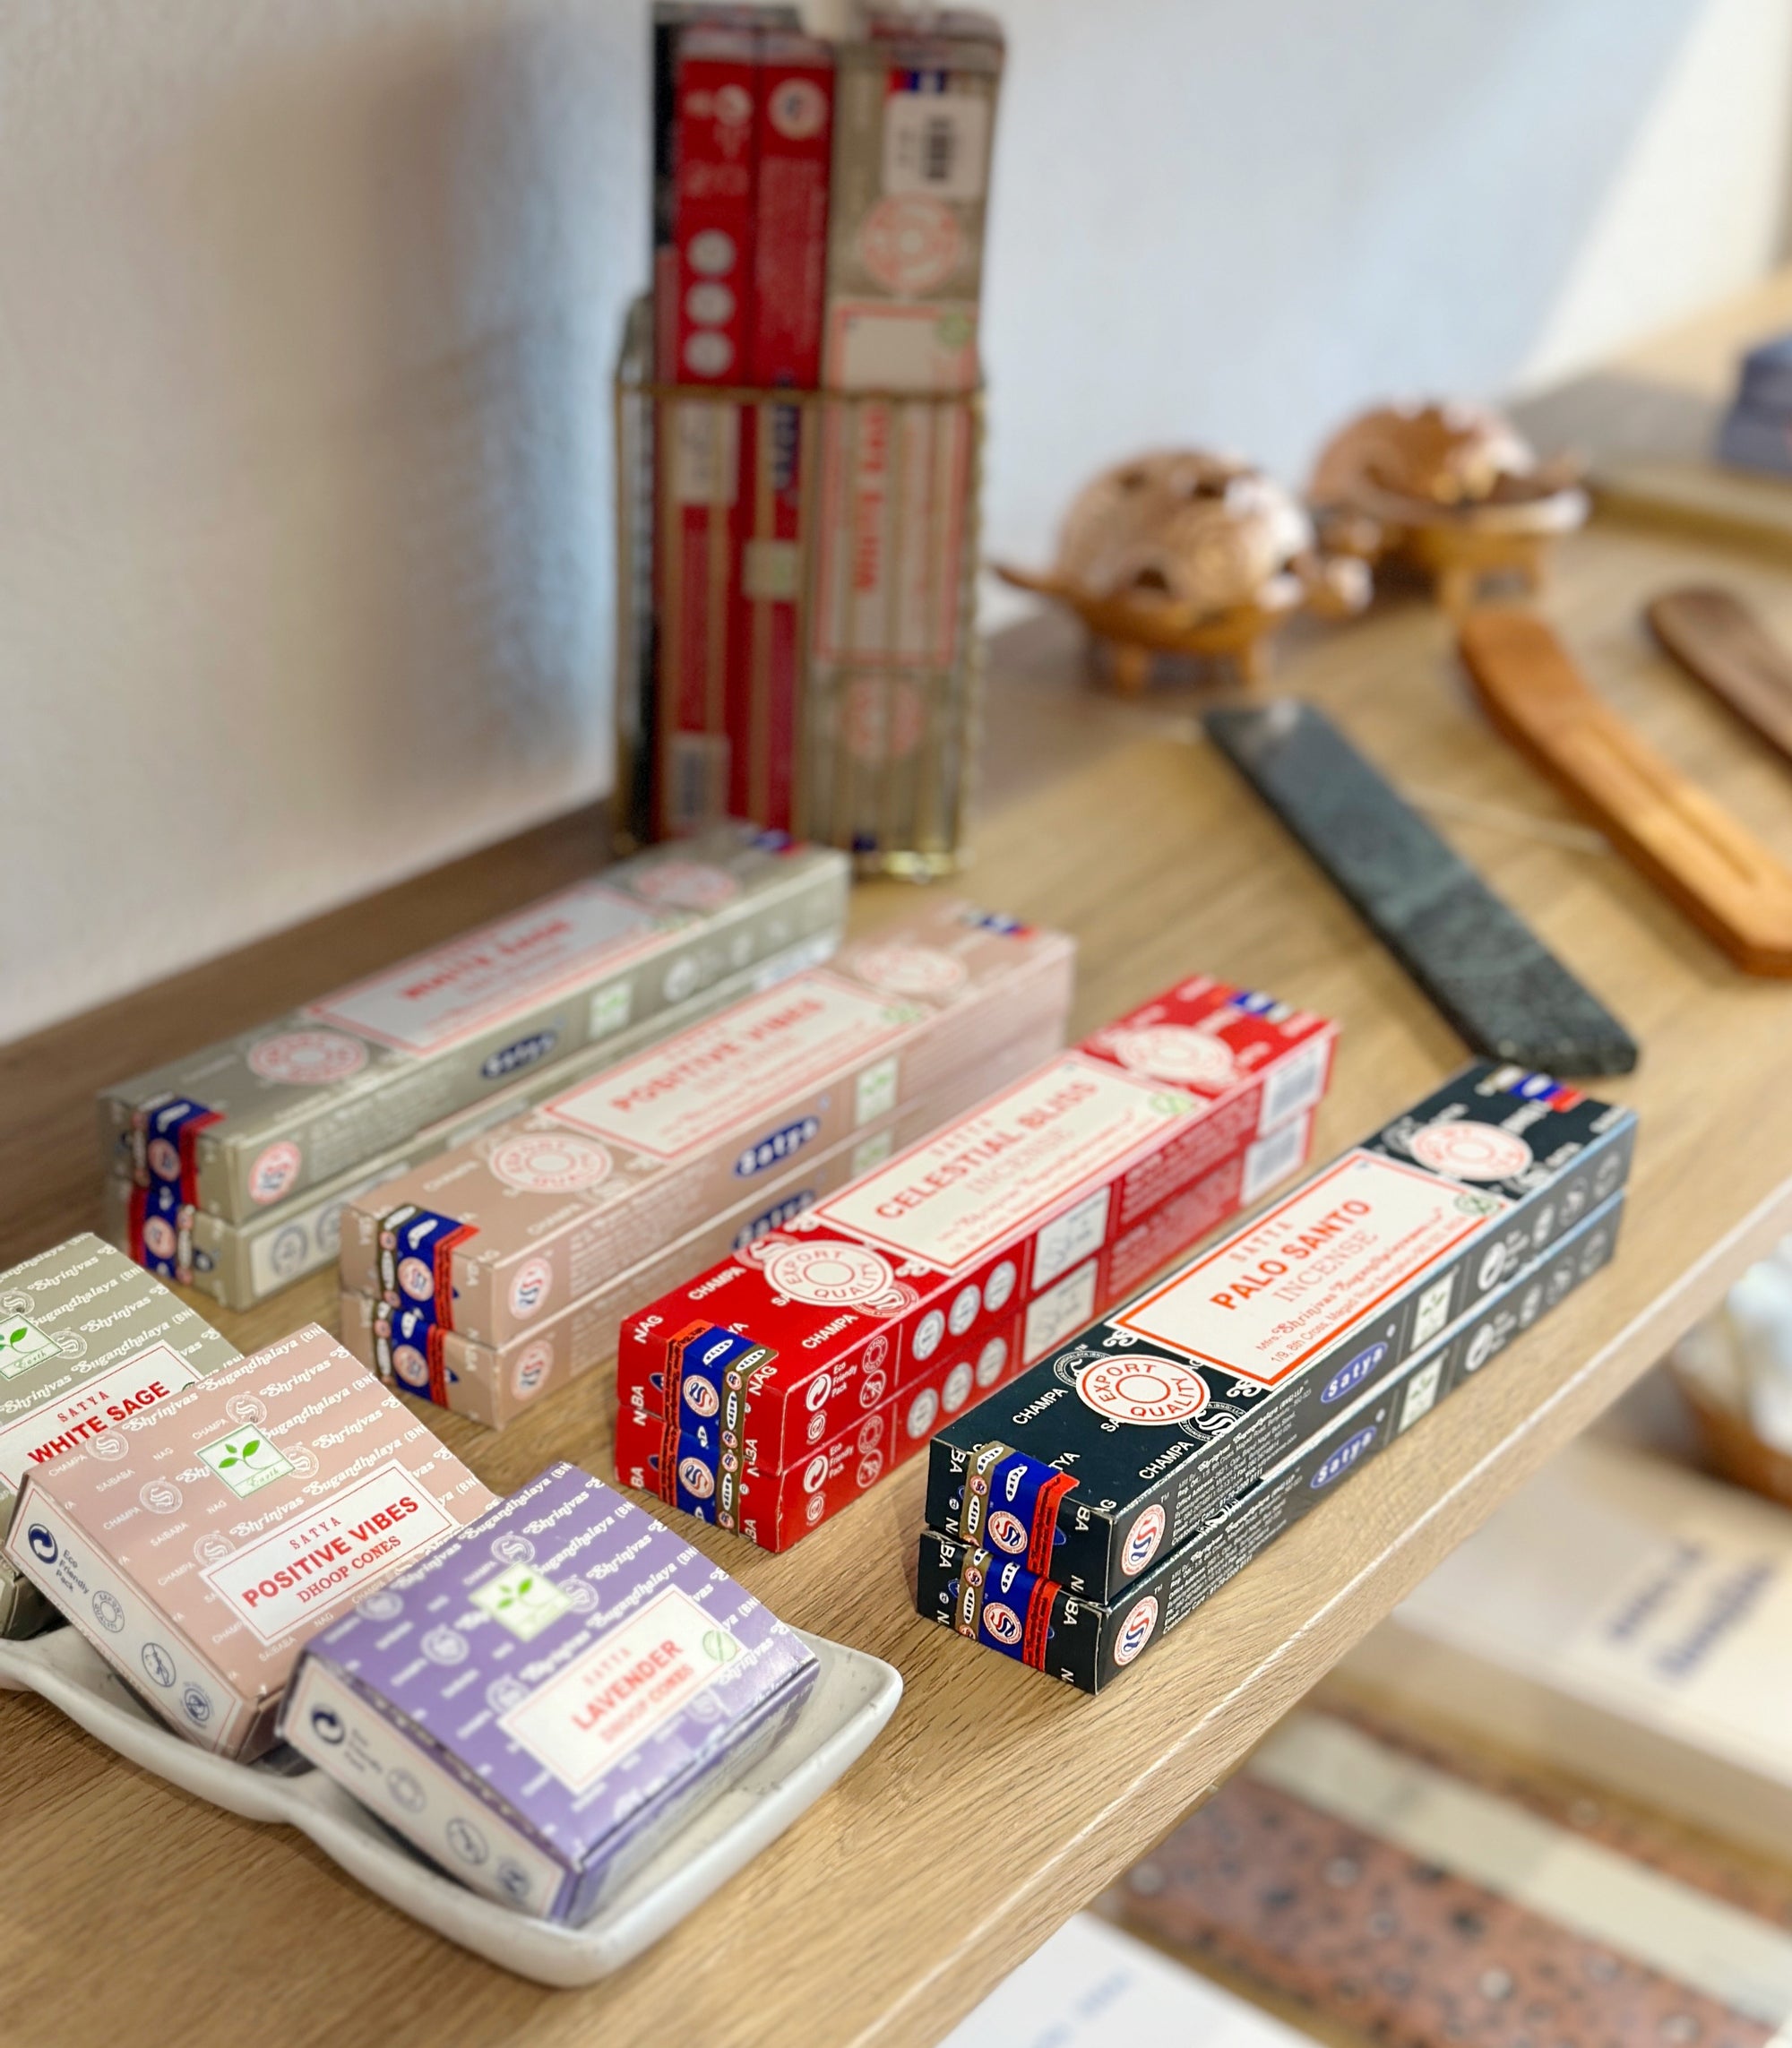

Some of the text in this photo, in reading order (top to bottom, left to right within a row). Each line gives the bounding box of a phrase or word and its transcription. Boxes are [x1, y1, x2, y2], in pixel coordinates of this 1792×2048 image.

[875, 1132, 1024, 1218] CELESTIAL
[27, 1256, 99, 1291] Shrinivas
[782, 1250, 842, 1286] EXPORT
[1210, 1259, 1288, 1311] PALO
[1281, 1200, 1373, 1260] SANTO
[1272, 1230, 1379, 1303] INCENSE
[687, 1265, 746, 1301] CHAMPA
[814, 1261, 877, 1299] QUALITY
[80, 1295, 151, 1333] Shrinivas
[633, 1315, 663, 1344] NAG
[802, 1313, 858, 1349] CHAMPA
[0, 1374, 73, 1415] Shrinivas
[71, 1321, 170, 1373] Sugandhalaya
[122, 1392, 199, 1432] Shrinivas
[197, 1338, 299, 1391] Sugandhalaya
[260, 1359, 332, 1398] Shrinivas
[748, 1365, 778, 1396] NAG
[1093, 1363, 1156, 1403] EXPORT
[1328, 1347, 1384, 1398] Satya
[56, 1390, 110, 1423] SATYA
[1012, 1386, 1068, 1425] CHAMPA
[1130, 1377, 1194, 1417] QUALITY
[27, 1381, 171, 1464] WHITE SAGE
[312, 1409, 383, 1449] Shrinivas
[48, 1454, 88, 1477] CHAMPA
[153, 1447, 174, 1461] NAG
[1048, 1451, 1081, 1471] TYA
[1139, 1440, 1194, 1480] CHAMPA
[1317, 1432, 1372, 1483] Satya
[206, 1499, 228, 1515] NAG
[229, 1496, 305, 1537] Shrinivas
[302, 1438, 403, 1496] Sugandhalaya
[103, 1506, 142, 1531] CHAMPA
[458, 1477, 552, 1540] Sugandhalaya
[523, 1491, 590, 1535] Shrinivas
[242, 1536, 352, 1608] POSITIVE
[348, 1496, 419, 1542] VIBES
[289, 1516, 342, 1551] SATYA
[63, 1549, 79, 1569] Eco
[157, 1561, 195, 1587] CHAMPA
[297, 1565, 349, 1604] DHOOP
[351, 1535, 401, 1570] CONES
[586, 1534, 652, 1580] Shrinivas
[56, 1570, 74, 1592] Pack
[59, 1560, 90, 1595] Friendly
[571, 1639, 684, 1731] LAVENDER
